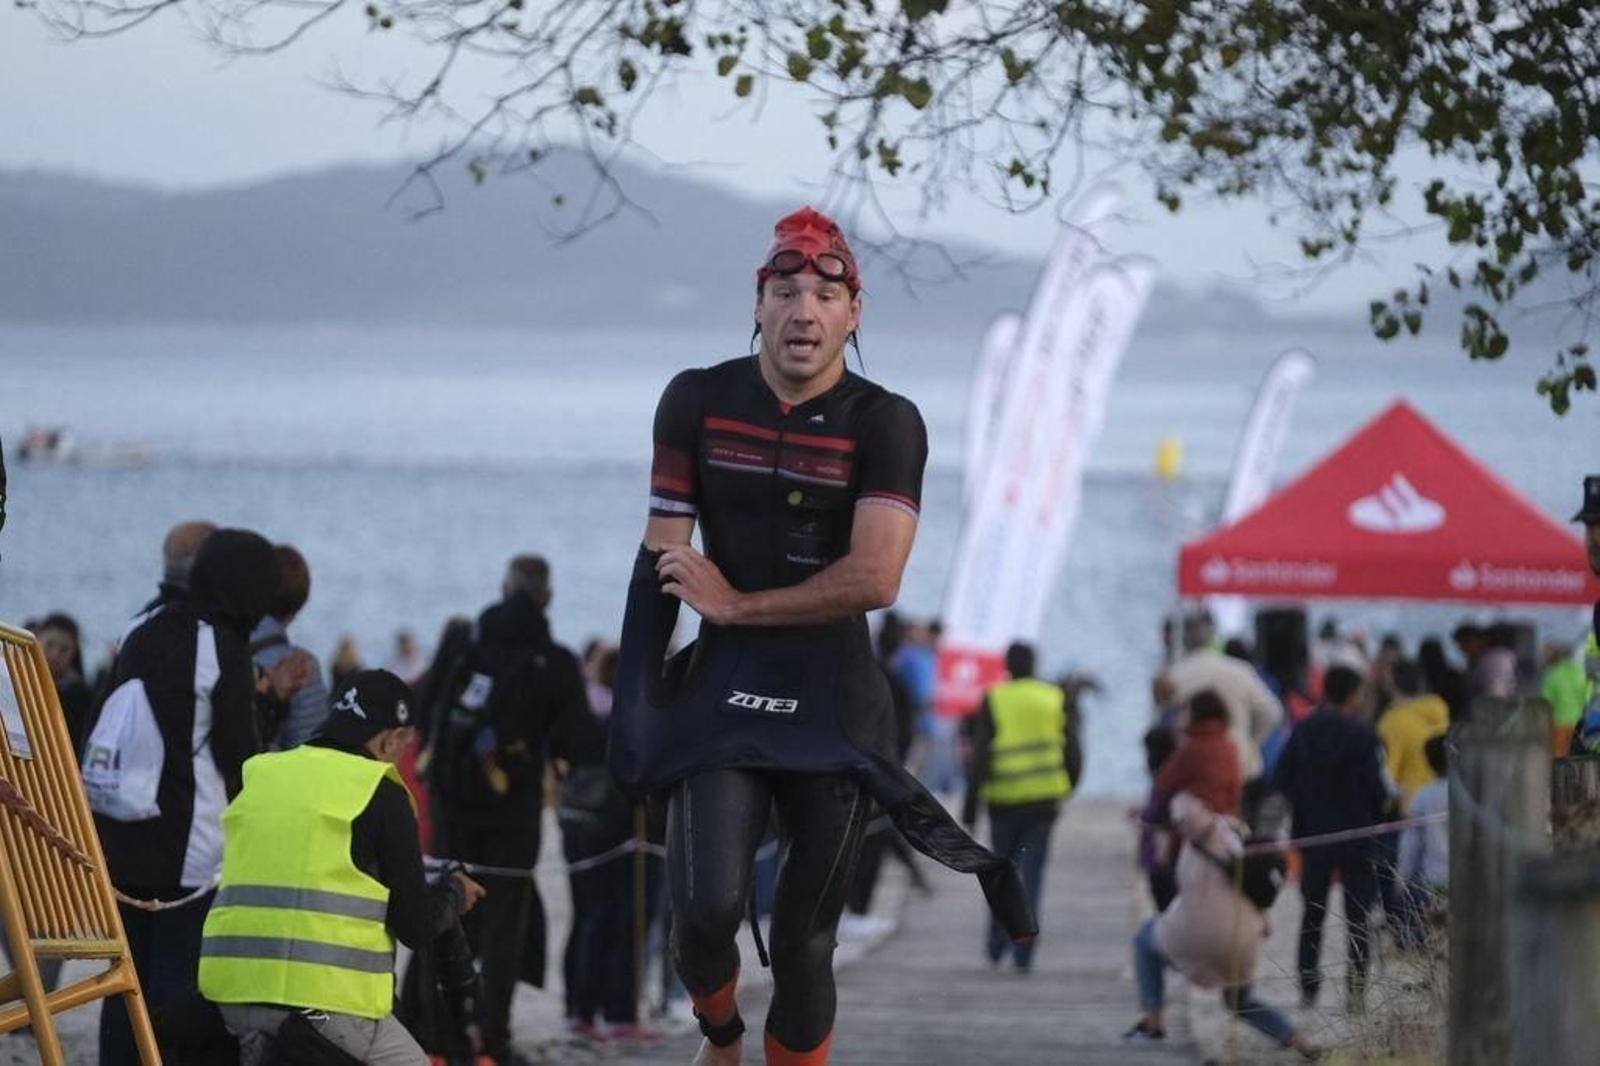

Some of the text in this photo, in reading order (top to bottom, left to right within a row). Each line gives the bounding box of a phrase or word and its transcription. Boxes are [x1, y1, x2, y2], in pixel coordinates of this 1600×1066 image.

[1231, 558, 1337, 586] Santander
[1479, 563, 1586, 592] Santander
[728, 691, 798, 713] ZONE3
